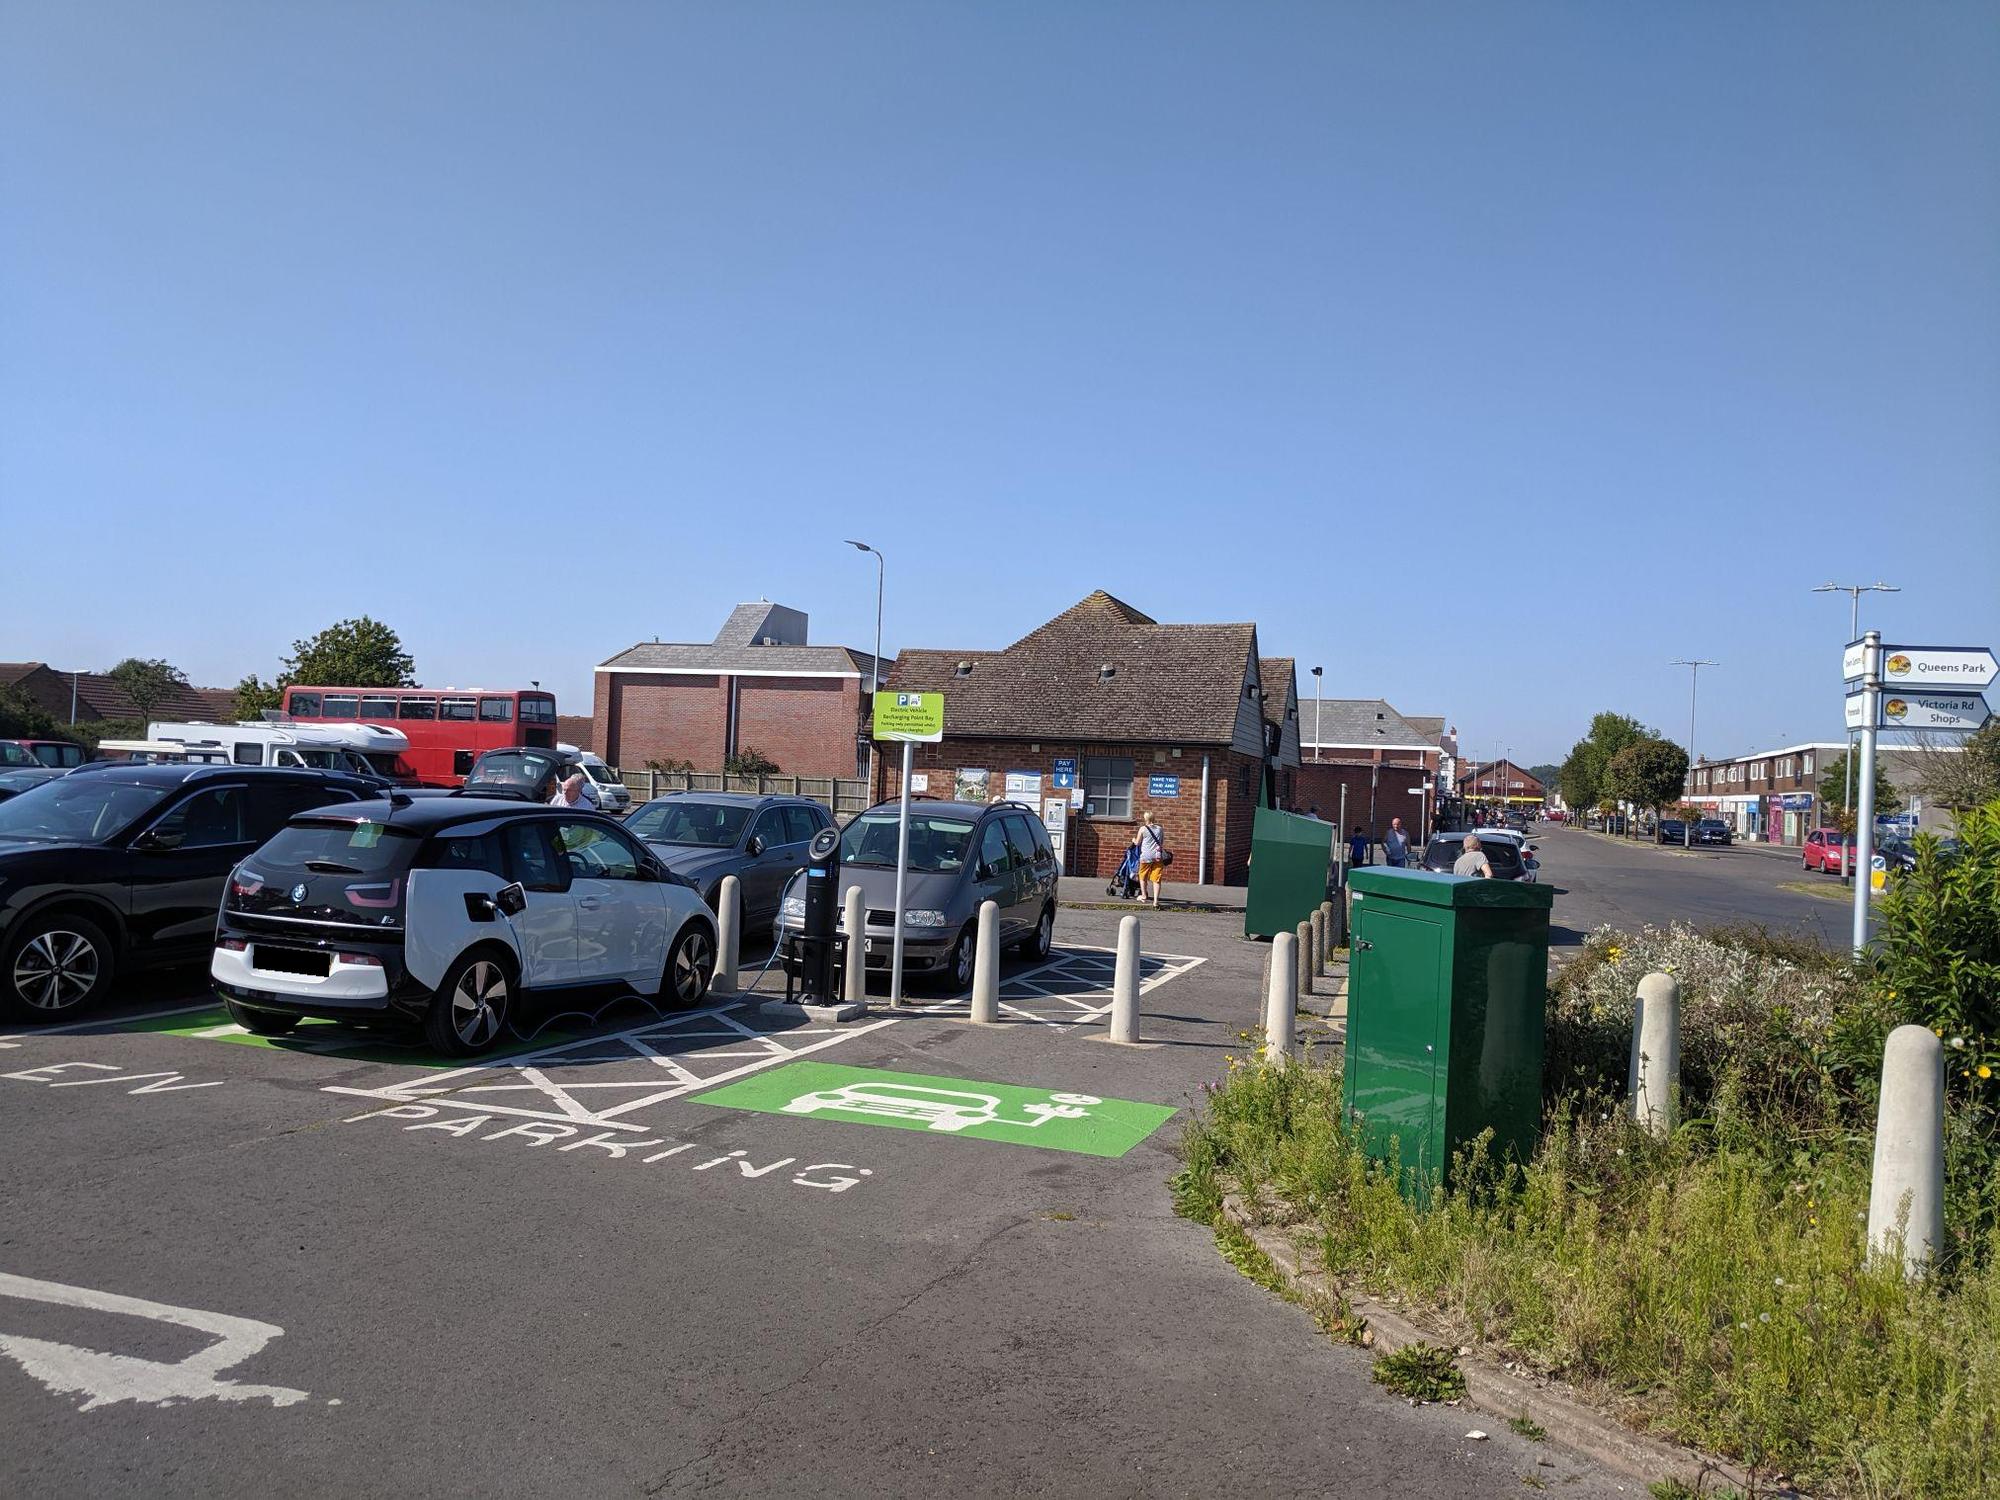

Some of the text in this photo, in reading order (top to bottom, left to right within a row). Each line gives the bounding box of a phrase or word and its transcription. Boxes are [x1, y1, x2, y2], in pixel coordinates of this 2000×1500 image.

[1918, 662, 1986, 673] Queens Park
[1918, 700, 1975, 710] Victoria Rd
[1930, 714, 1961, 724] Shops
[342, 1105, 874, 1193] PARKING
